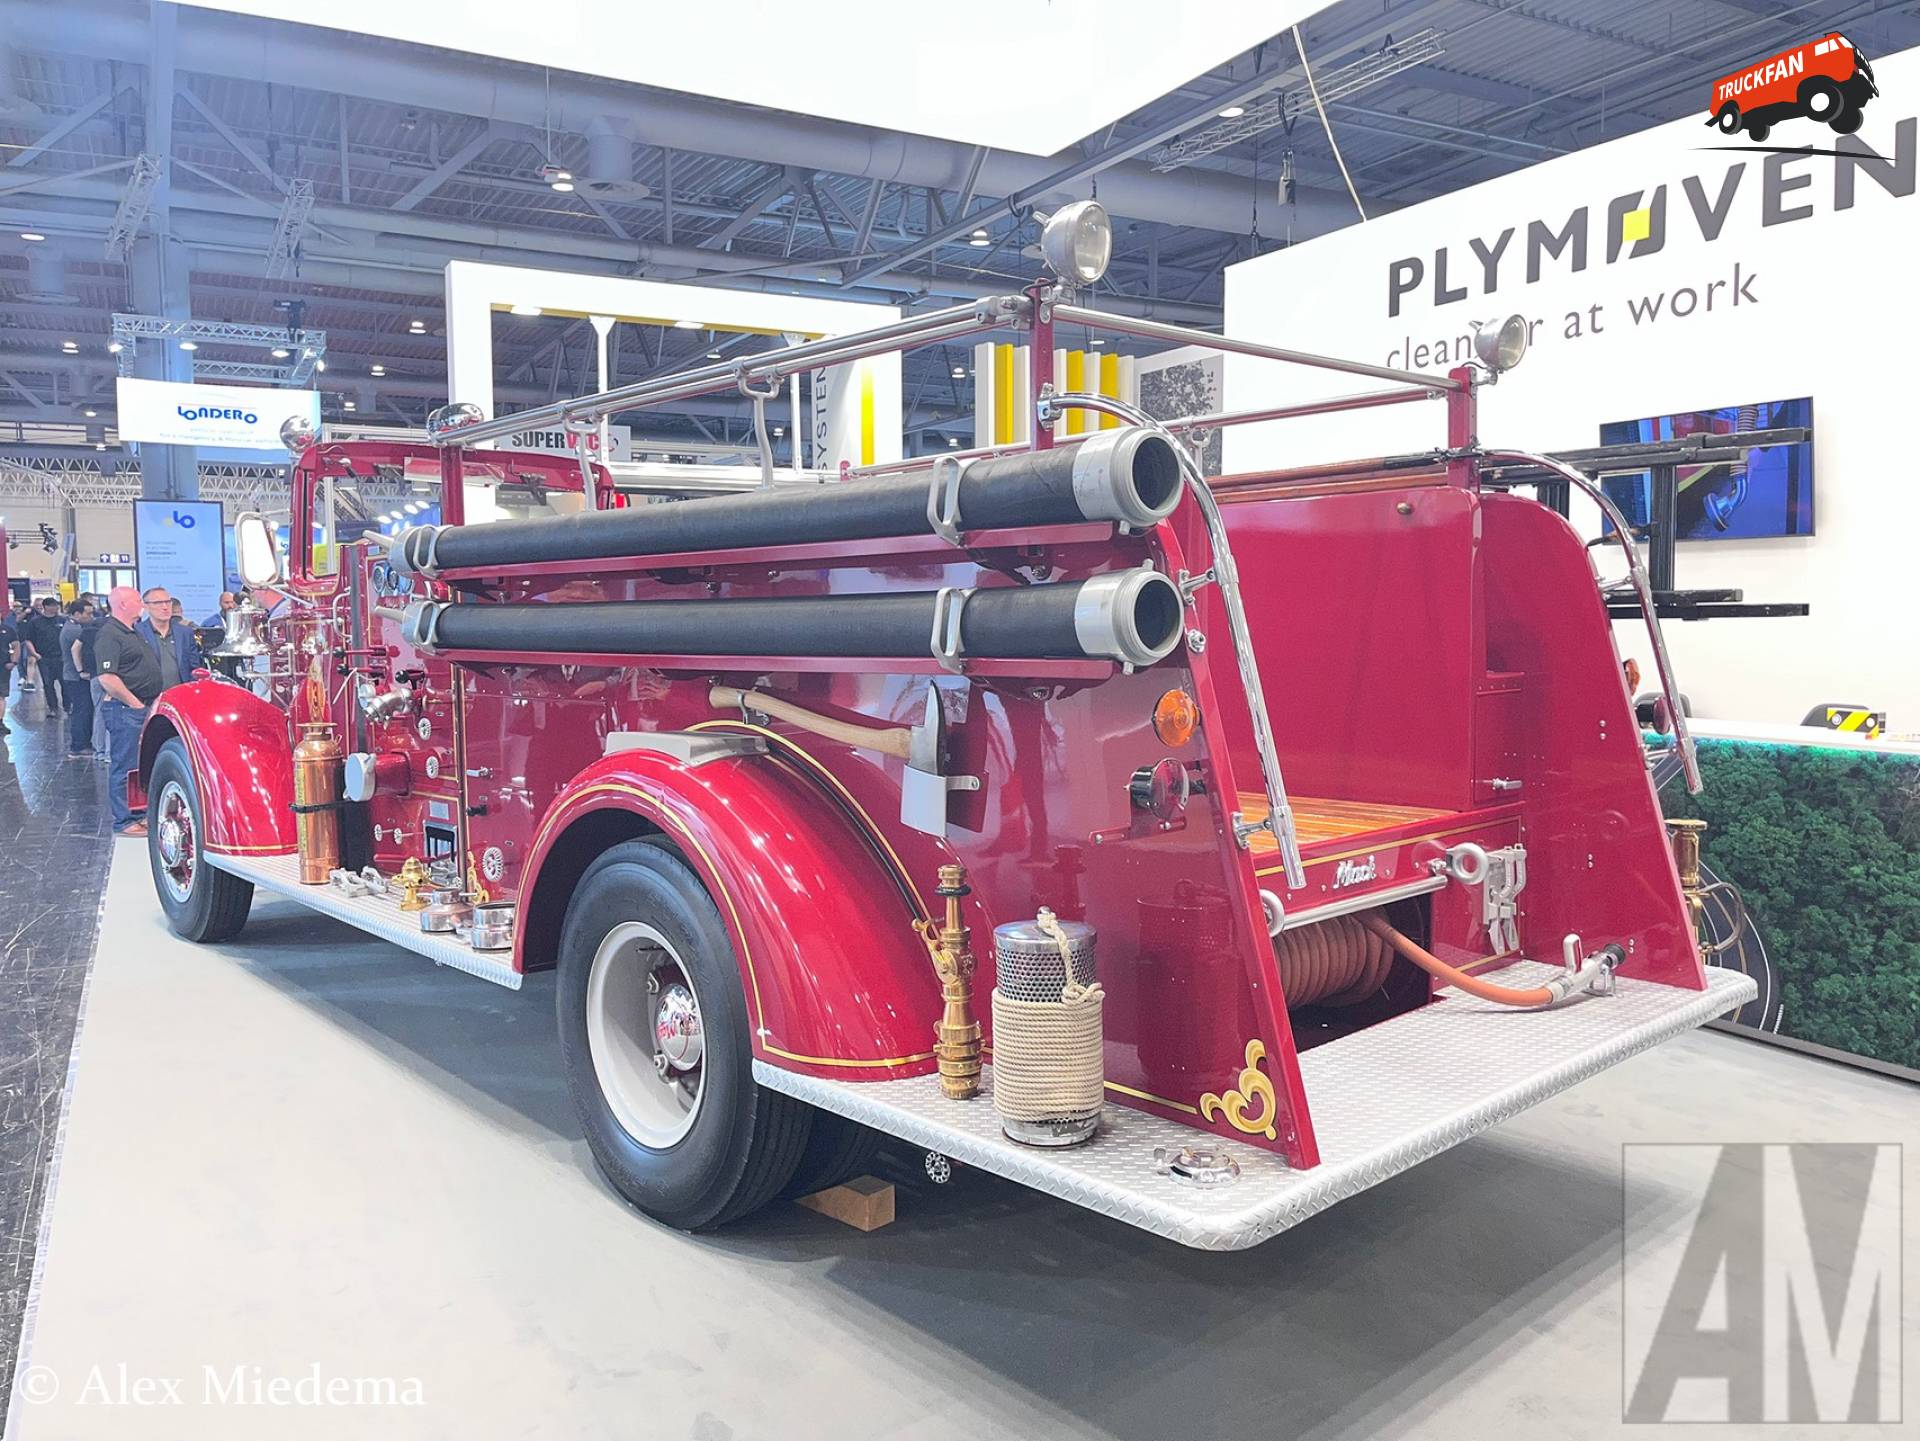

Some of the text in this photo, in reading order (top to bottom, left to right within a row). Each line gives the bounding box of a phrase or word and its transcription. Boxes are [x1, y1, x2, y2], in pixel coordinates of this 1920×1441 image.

[1388, 117, 1918, 317] PLYMOVEN
[1387, 262, 1759, 371] cleanr at work
[177, 405, 258, 425] LONDERO
[511, 430, 600, 451] SUPERVC
[1332, 855, 1377, 889] Mack
